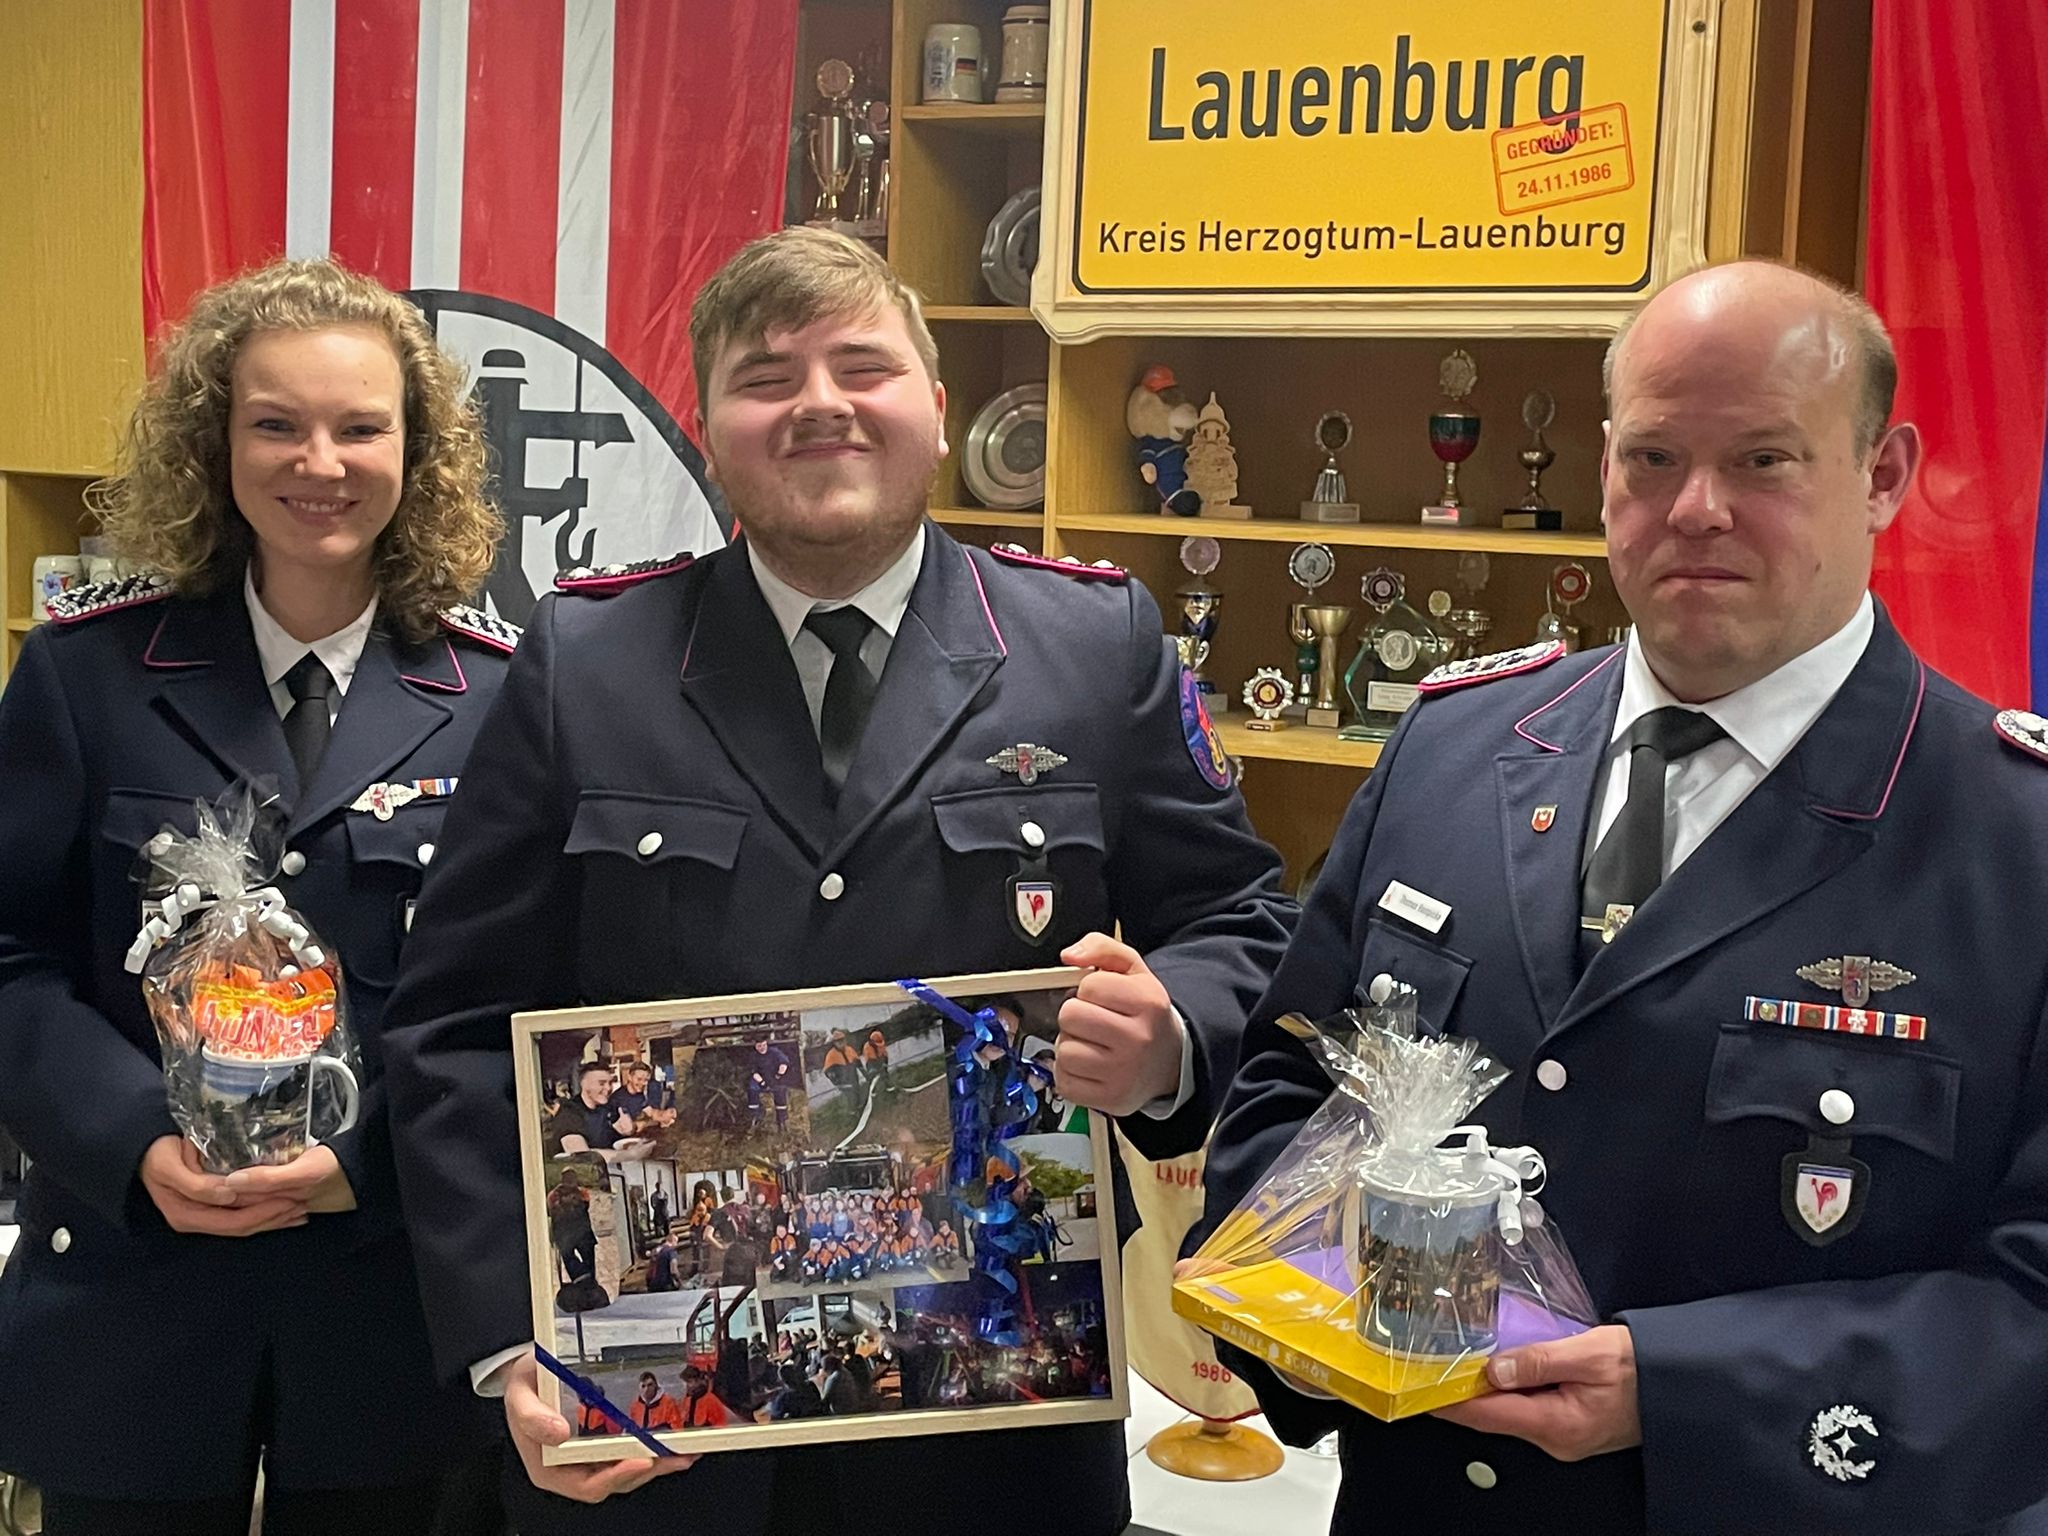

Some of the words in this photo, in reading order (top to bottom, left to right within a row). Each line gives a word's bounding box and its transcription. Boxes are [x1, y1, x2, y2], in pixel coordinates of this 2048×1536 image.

[1148, 34, 1585, 155] Lauenburg
[1506, 121, 1614, 160] GEGRÜNDET:
[1517, 162, 1613, 198] 24.11.1986
[1099, 221, 1186, 253] Kreis
[1199, 215, 1625, 259] Herzogtum-Lauenburg
[1156, 1162, 1204, 1190] LAUE
[1191, 1360, 1232, 1384] 1986
